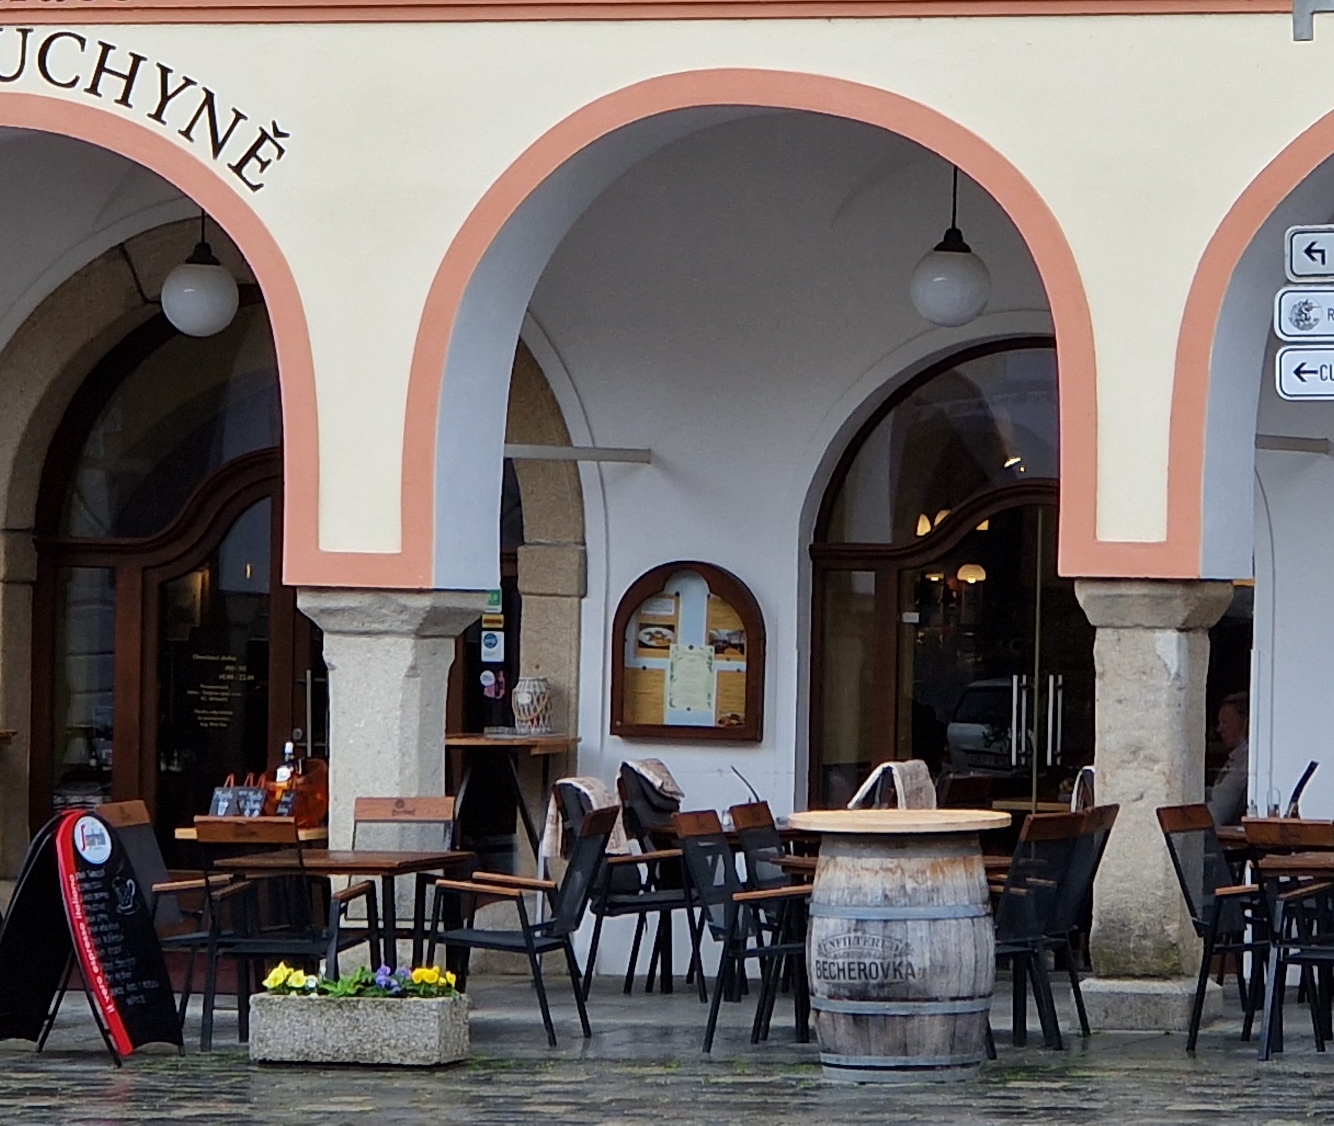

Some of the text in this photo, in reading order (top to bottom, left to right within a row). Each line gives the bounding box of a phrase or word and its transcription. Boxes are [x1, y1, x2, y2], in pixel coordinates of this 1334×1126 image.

[68, 873, 83, 920] italiano
[78, 923, 100, 974] espresso
[815, 959, 917, 981] BECHEROVKA
